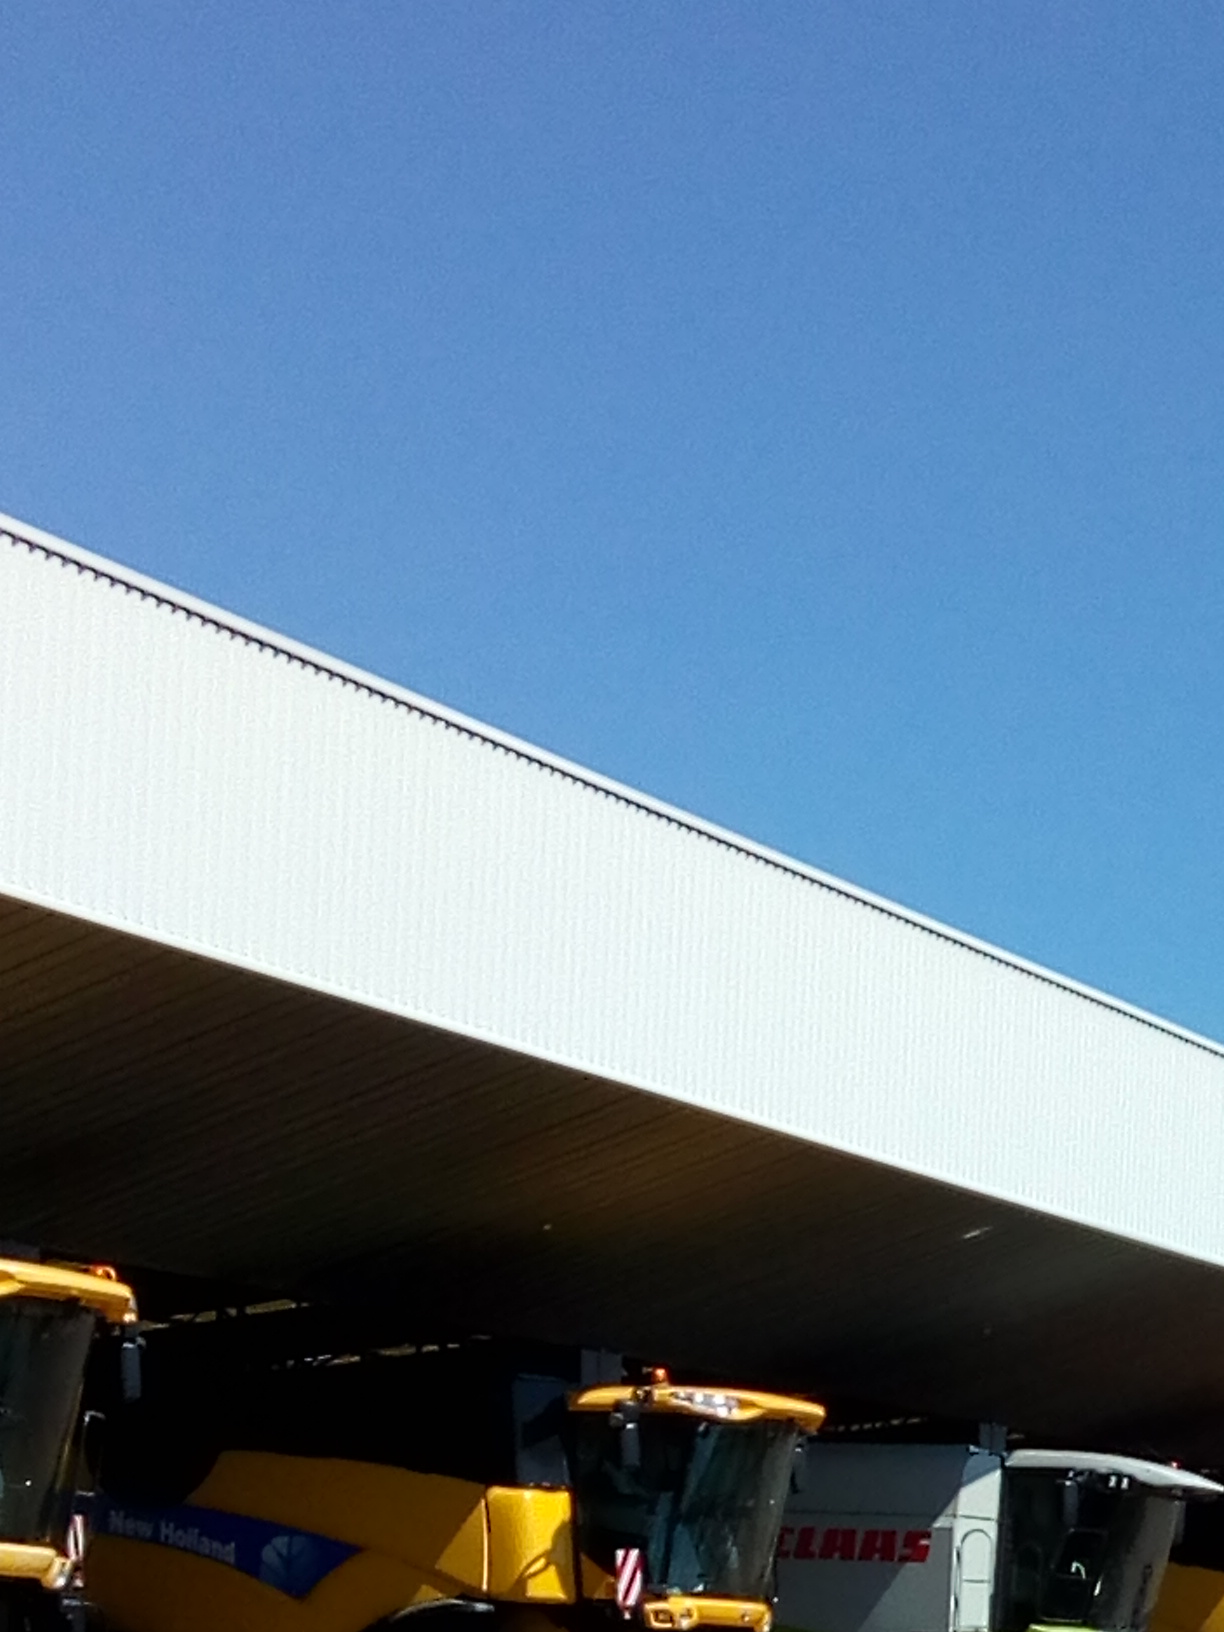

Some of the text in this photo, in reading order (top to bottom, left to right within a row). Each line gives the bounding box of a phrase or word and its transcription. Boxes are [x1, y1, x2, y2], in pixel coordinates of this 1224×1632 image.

[107, 1509, 236, 1564] New Holland
[777, 1527, 932, 1563] CLAAS
